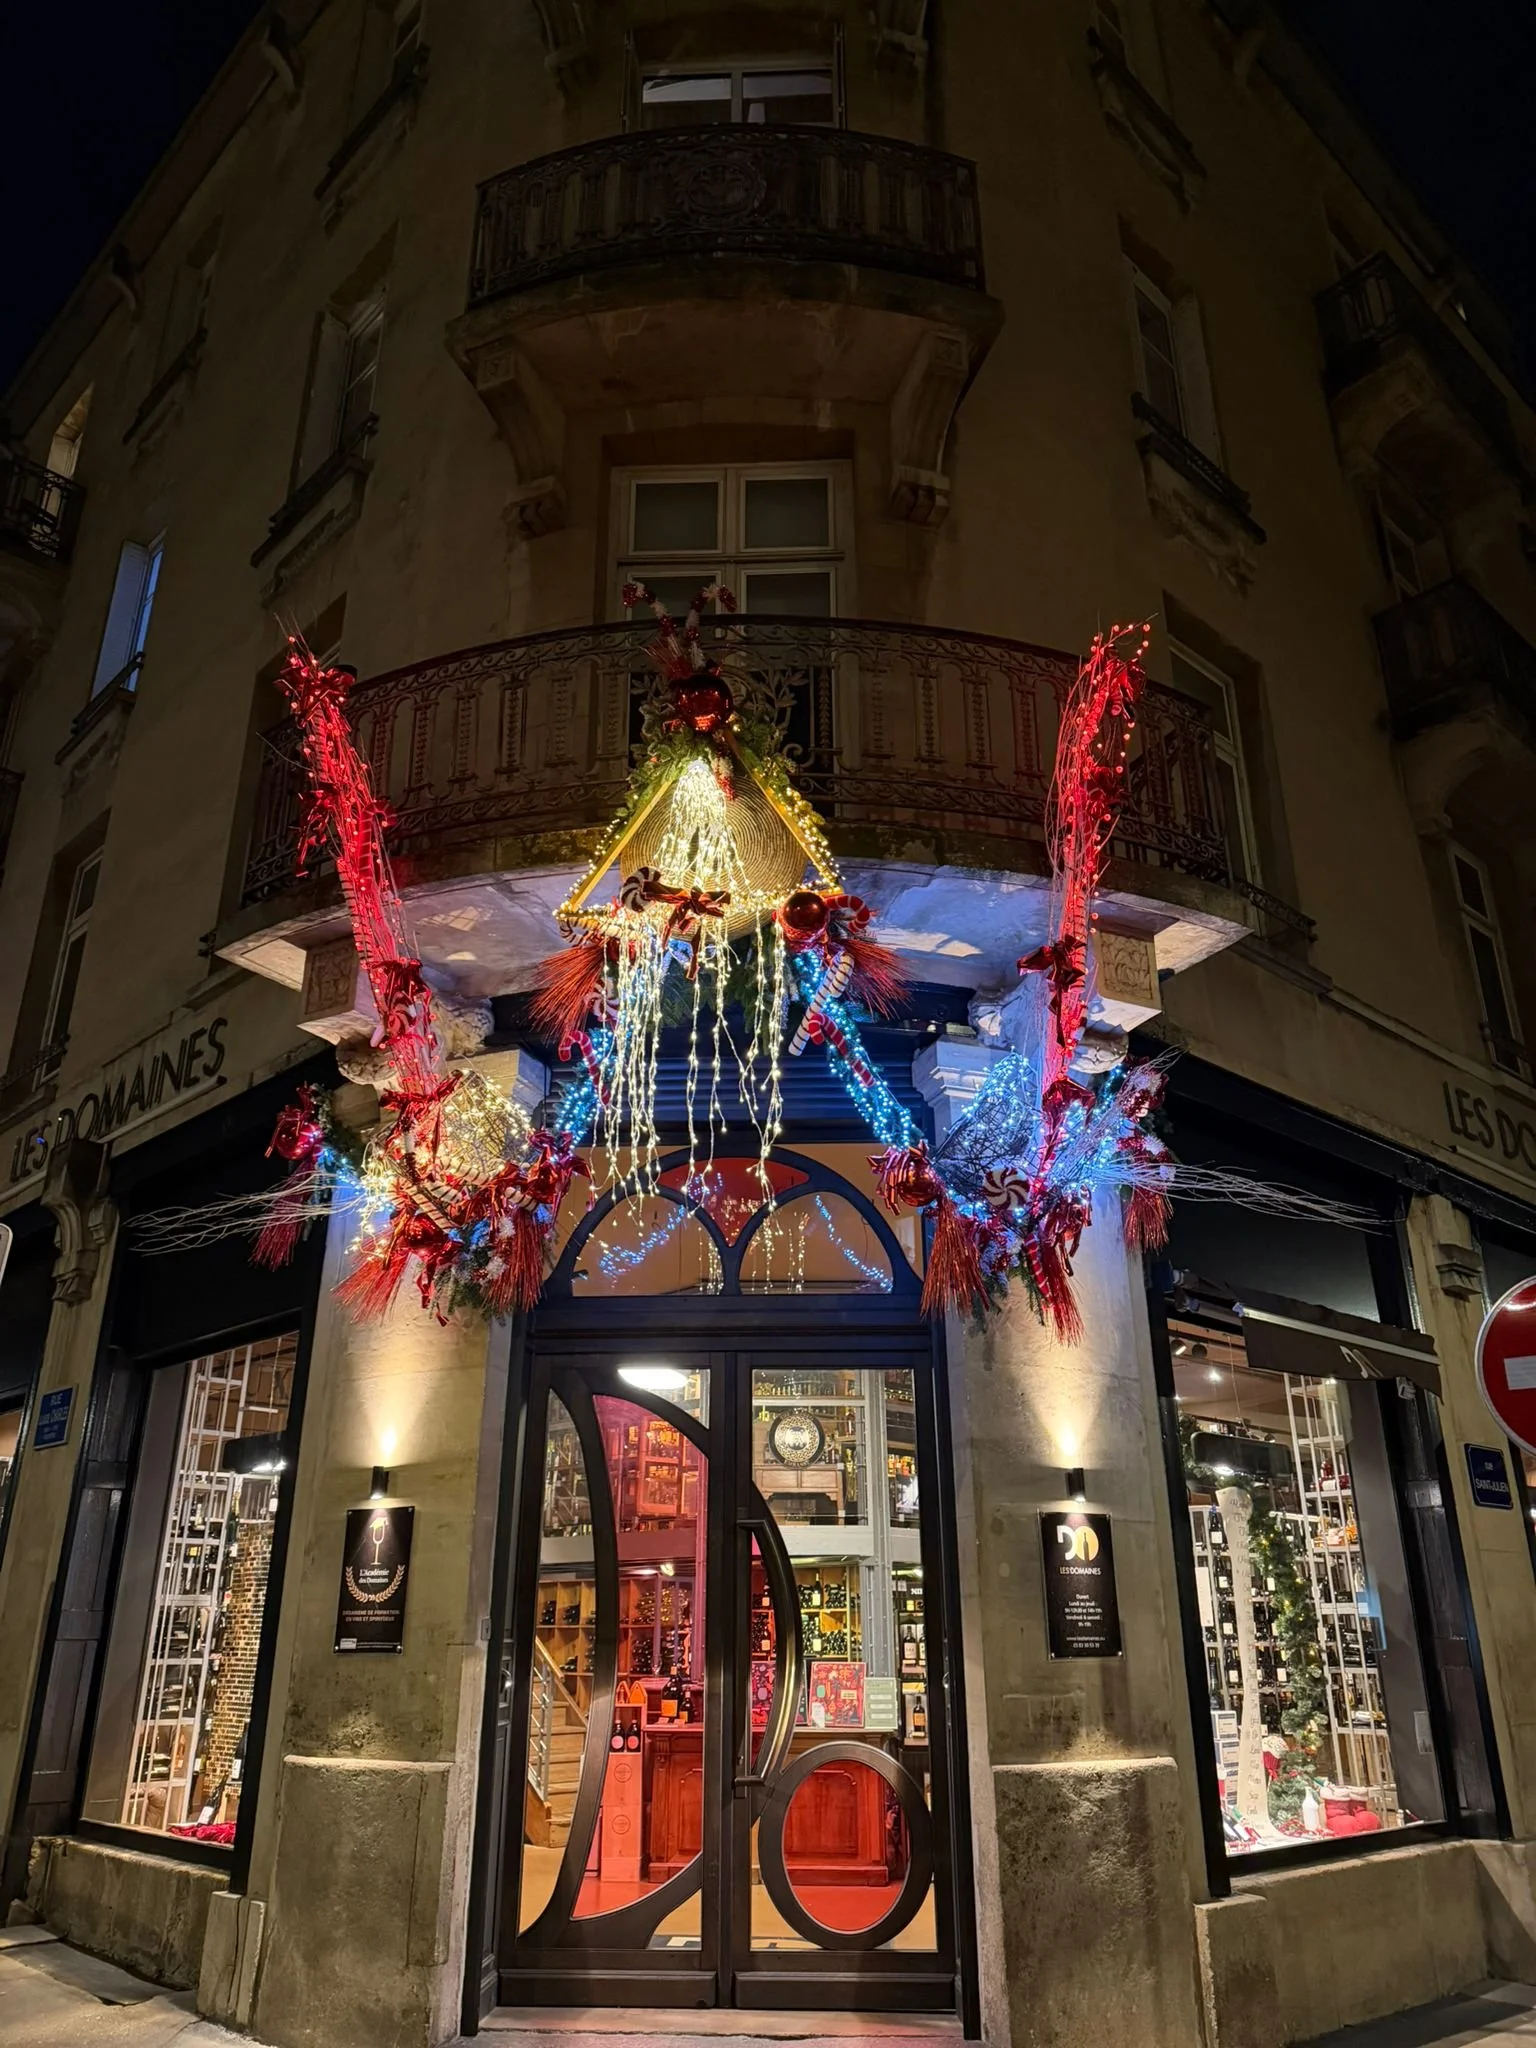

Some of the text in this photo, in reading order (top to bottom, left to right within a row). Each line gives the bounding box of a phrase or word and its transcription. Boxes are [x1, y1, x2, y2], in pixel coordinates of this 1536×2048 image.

[10, 1017, 228, 1182] LES DOMAINES
[1442, 1081, 1495, 1149] LES
